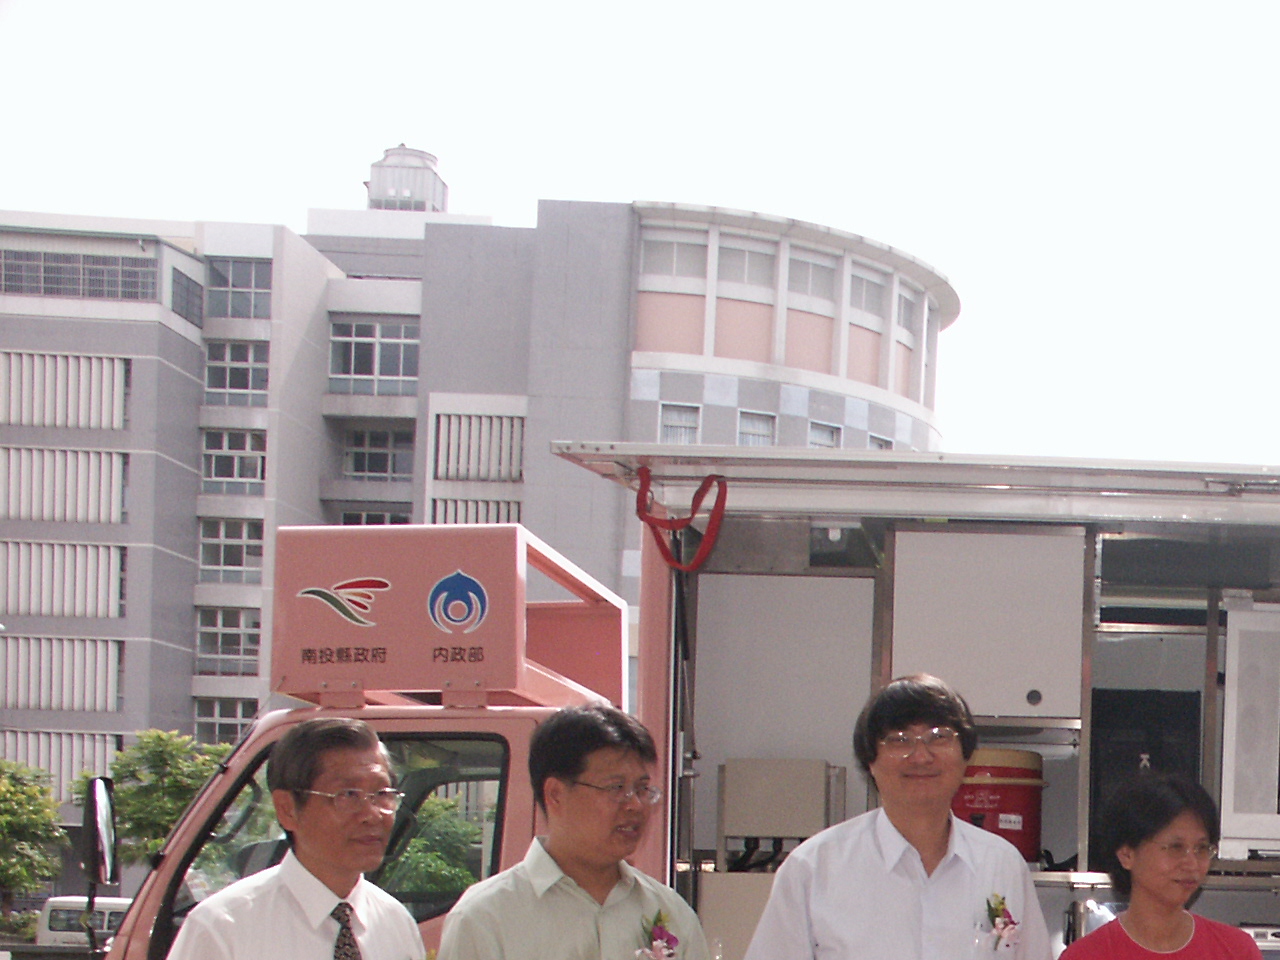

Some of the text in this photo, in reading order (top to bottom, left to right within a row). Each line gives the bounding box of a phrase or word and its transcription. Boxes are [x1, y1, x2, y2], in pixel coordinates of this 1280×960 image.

[301, 646, 387, 664] 南投縣政府
